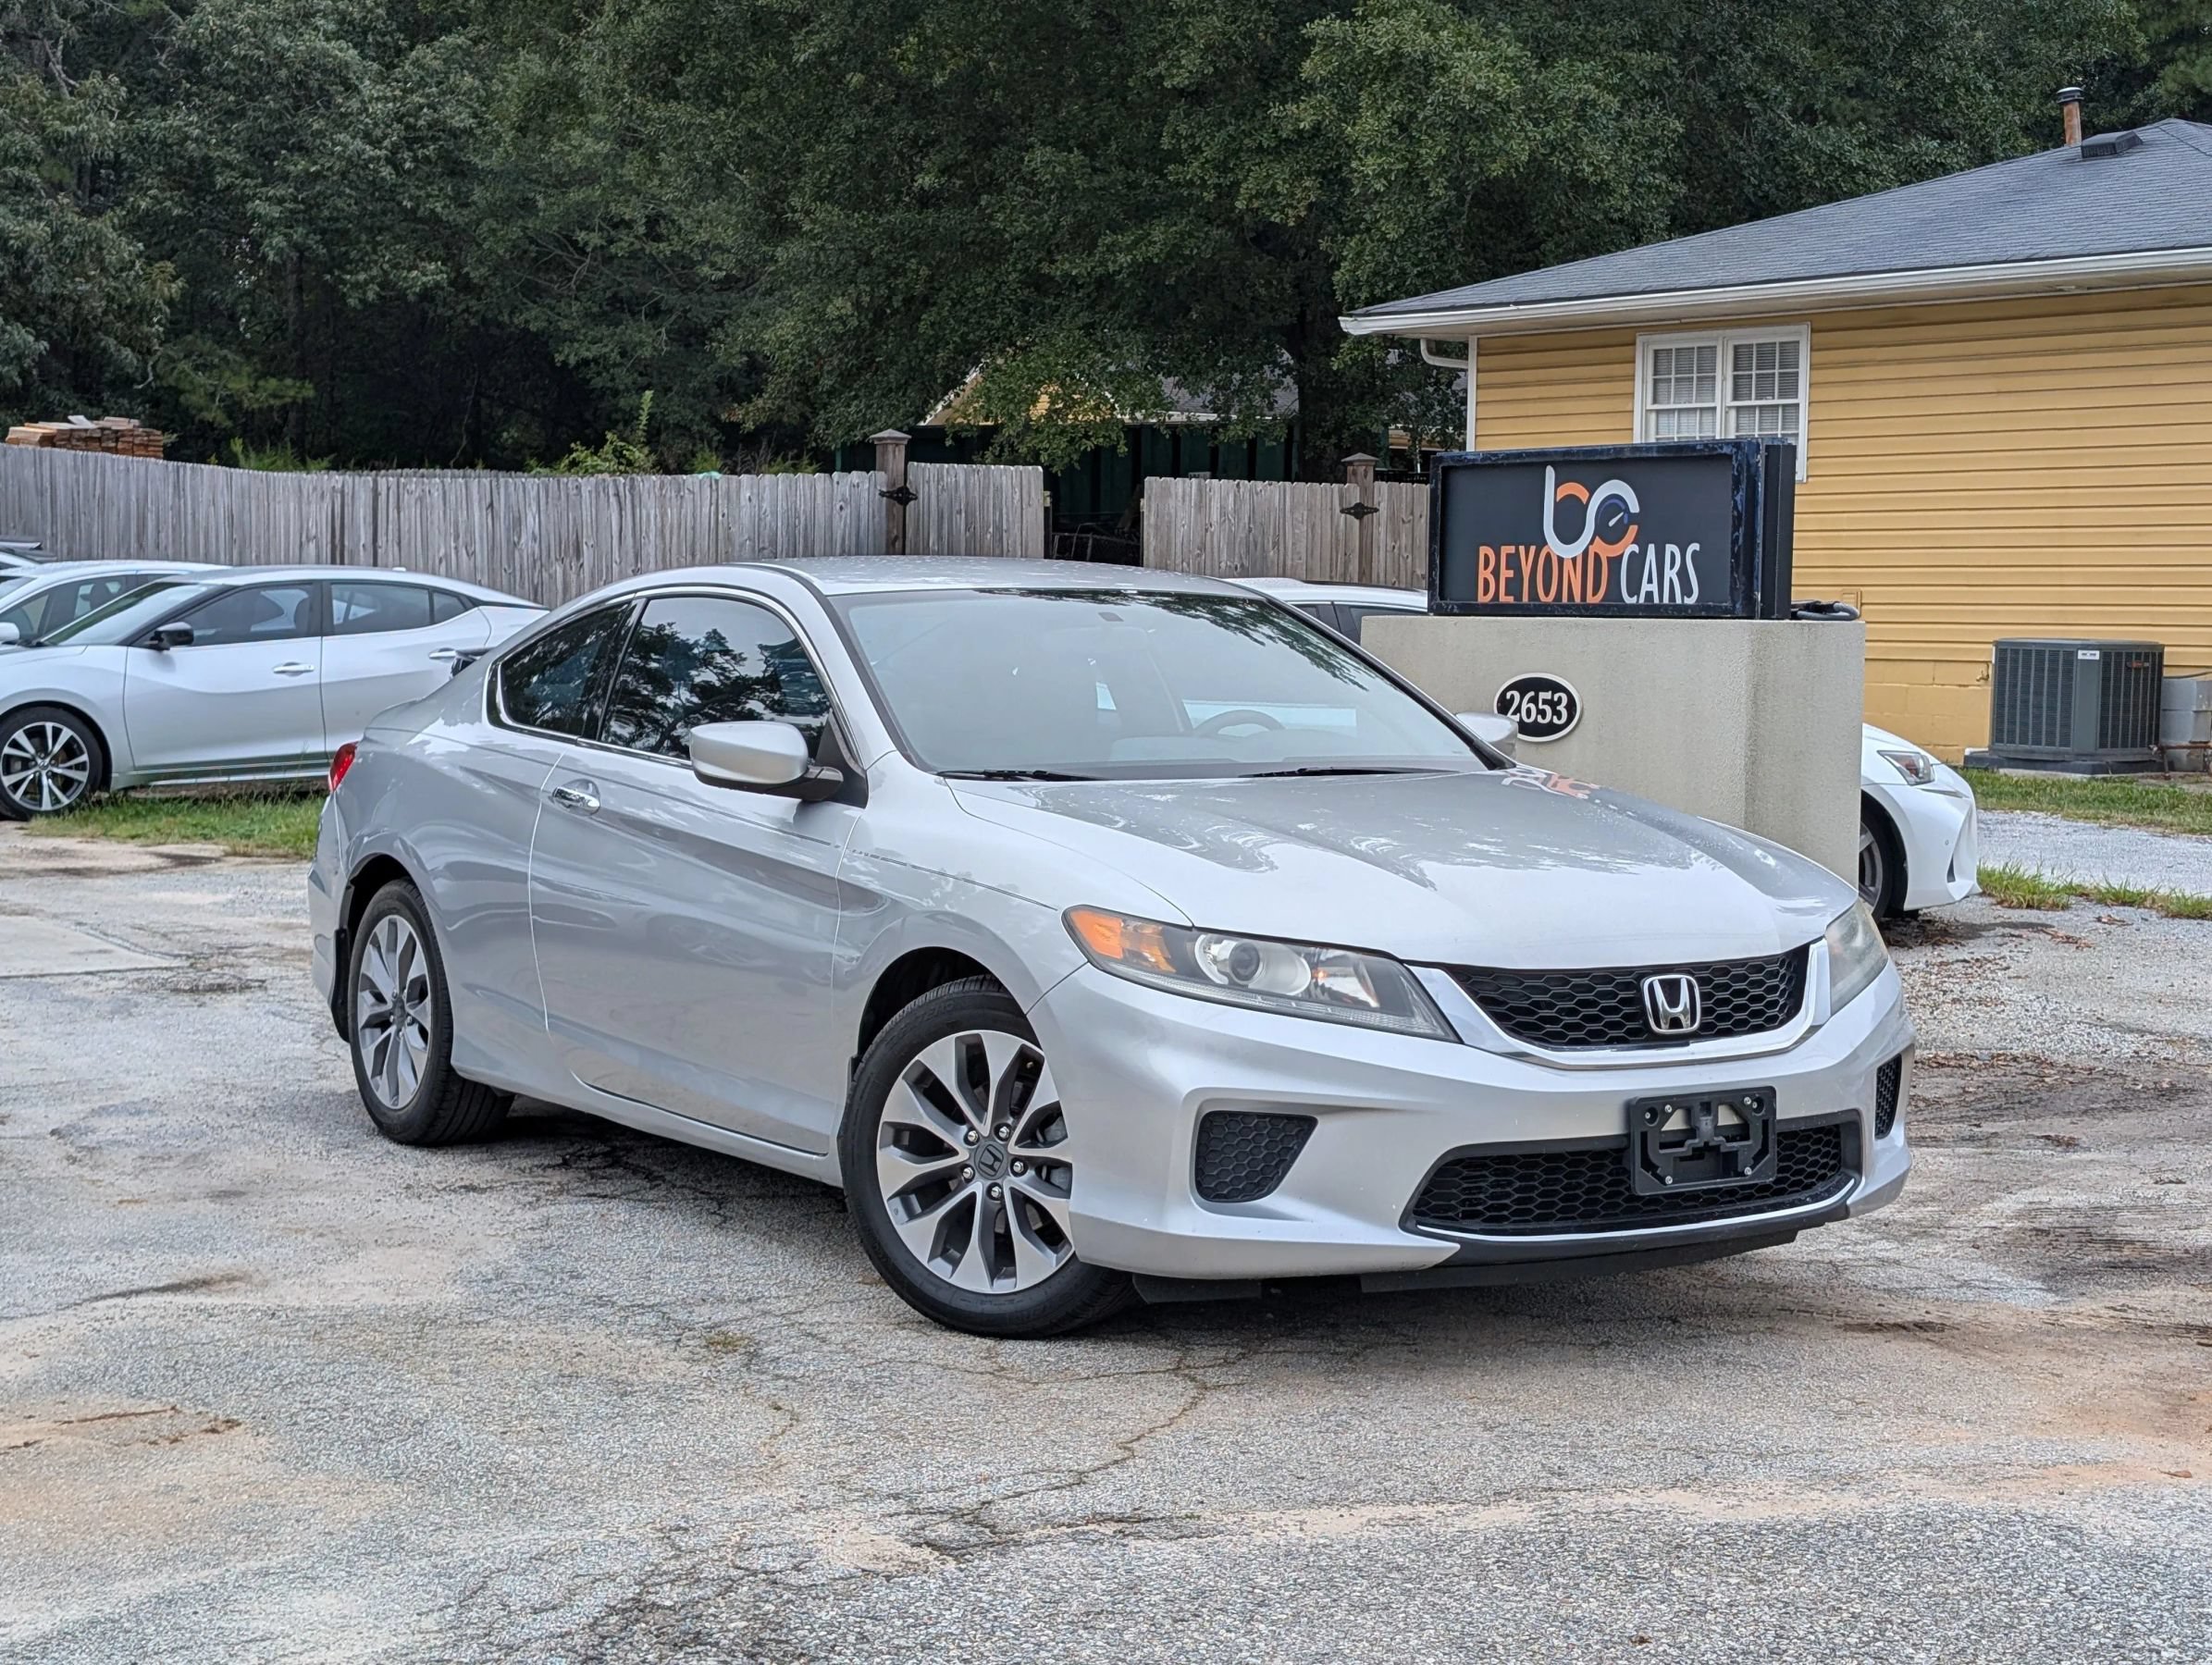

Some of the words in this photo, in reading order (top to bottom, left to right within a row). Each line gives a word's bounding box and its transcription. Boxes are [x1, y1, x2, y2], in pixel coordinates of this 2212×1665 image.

[1477, 545, 1608, 604] BEYOND
[1621, 543, 1700, 604] CARS
[1506, 690, 1568, 724] 2653
